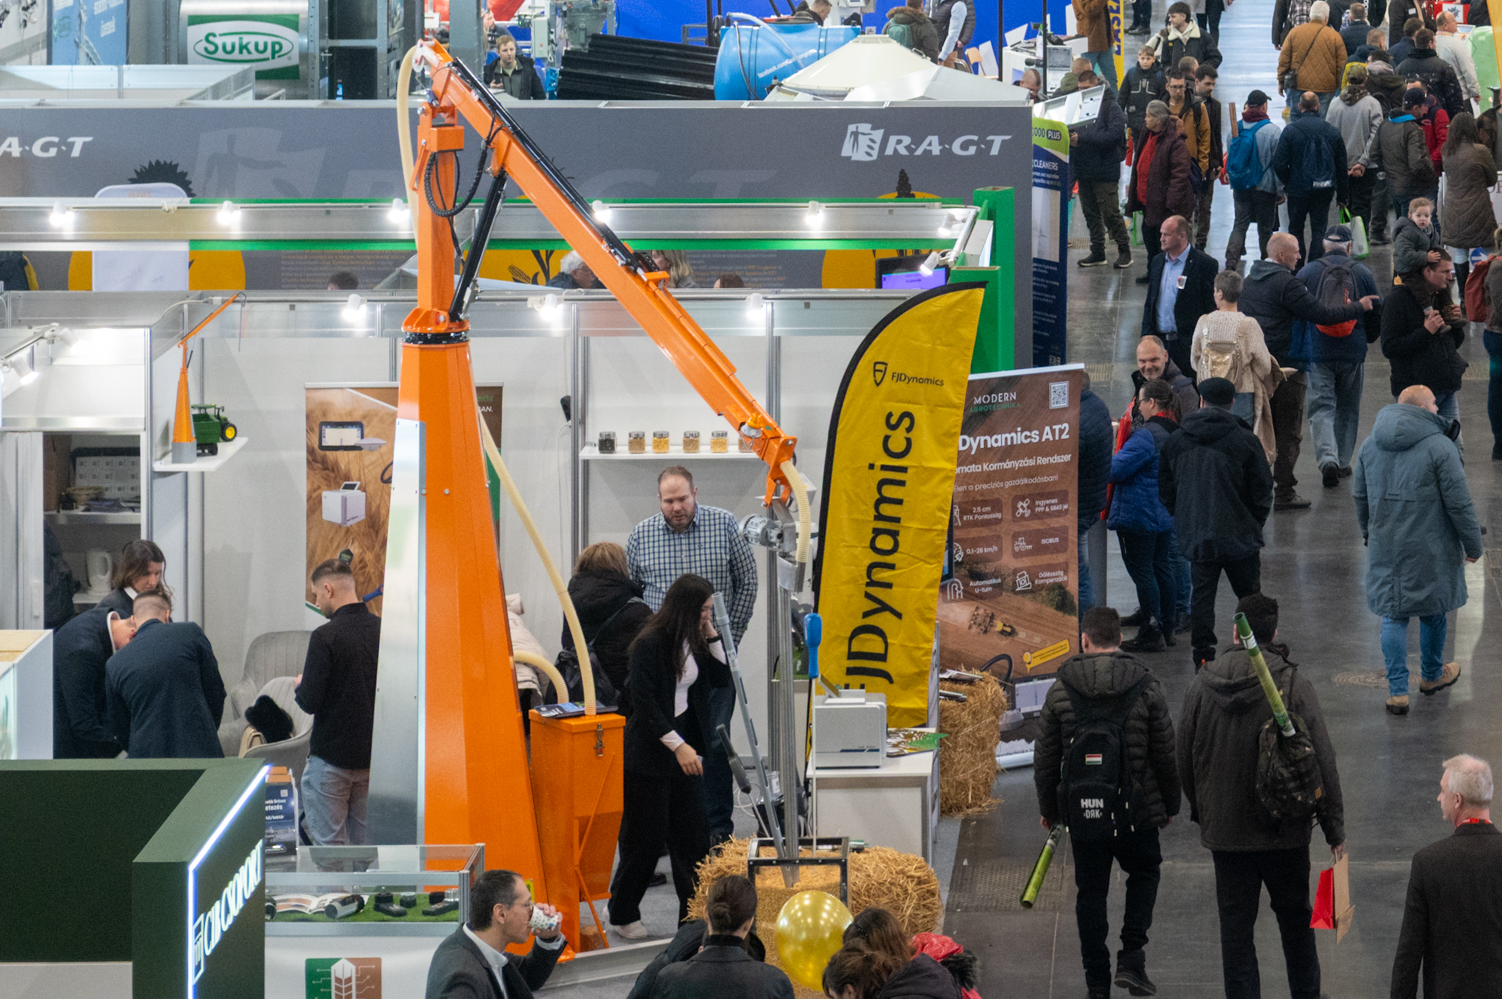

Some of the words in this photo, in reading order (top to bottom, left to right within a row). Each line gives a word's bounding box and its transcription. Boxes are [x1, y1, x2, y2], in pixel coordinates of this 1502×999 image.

[203, 32, 284, 61] Sukup
[1048, 130, 1061, 140] PLUS
[891, 371, 945, 387] FJDynamics
[973, 391, 1017, 405] MODERN
[969, 402, 1021, 413] AGROTECHNIKA
[958, 427, 1040, 455] Dynamics
[1041, 423, 1070, 442] AT2
[983, 456, 1036, 471] Kormányzási
[1037, 453, 1072, 465] Rendszer
[1081, 798, 1104, 808] HUN
[204, 900, 221, 956] CIB
[221, 839, 263, 932] CSOPORT
